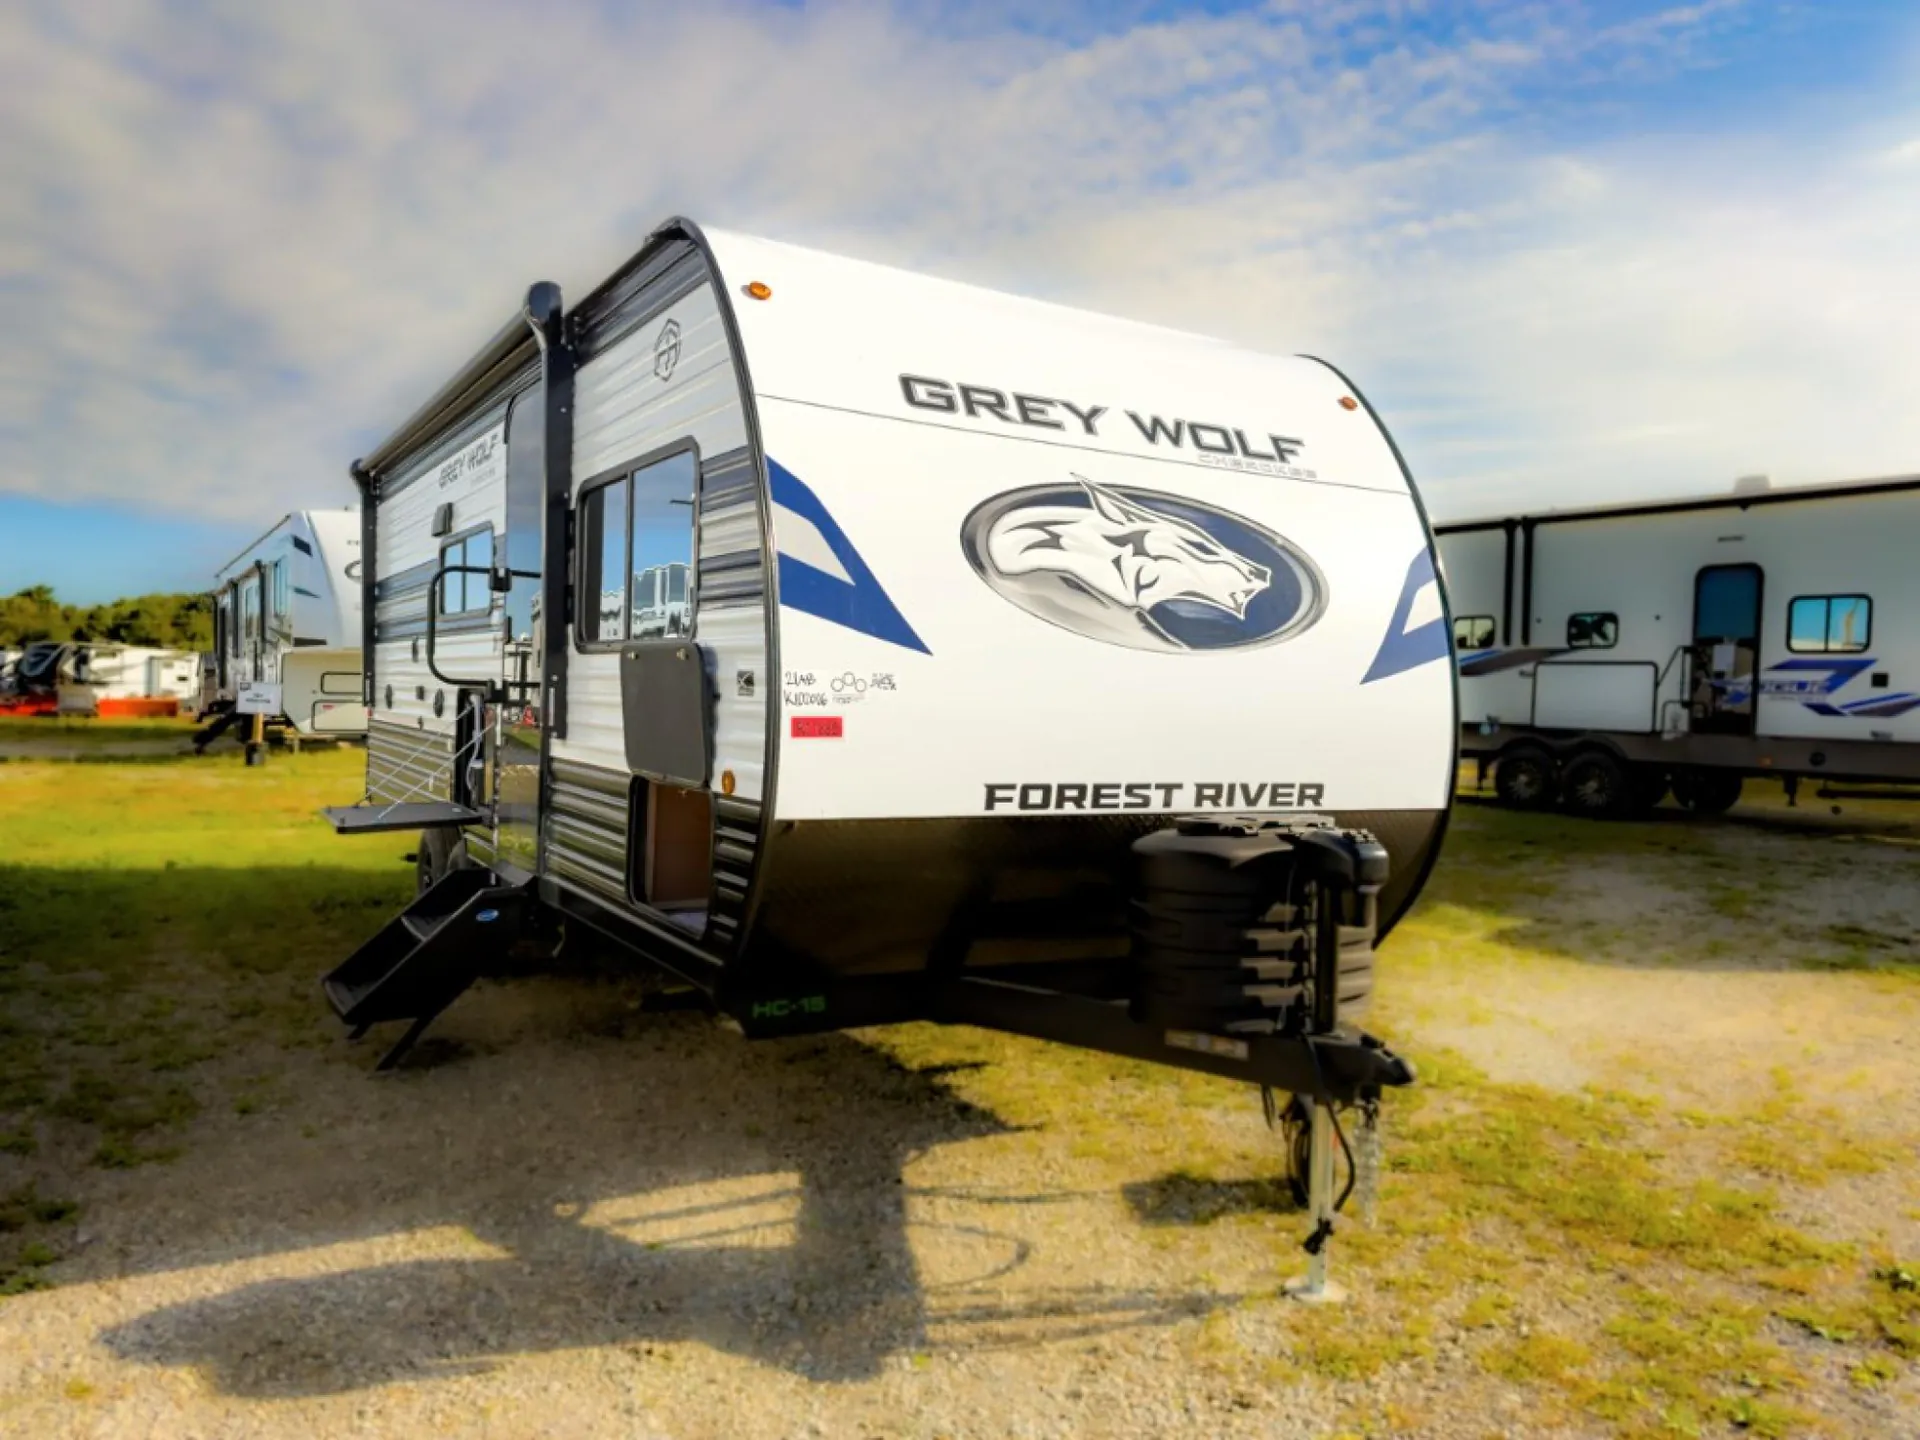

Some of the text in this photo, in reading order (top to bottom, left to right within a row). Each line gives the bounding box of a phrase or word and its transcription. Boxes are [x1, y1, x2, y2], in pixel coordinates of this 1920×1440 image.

[898, 373, 1306, 464] GREY WOLF
[984, 782, 1325, 811] FOREST RIVER
